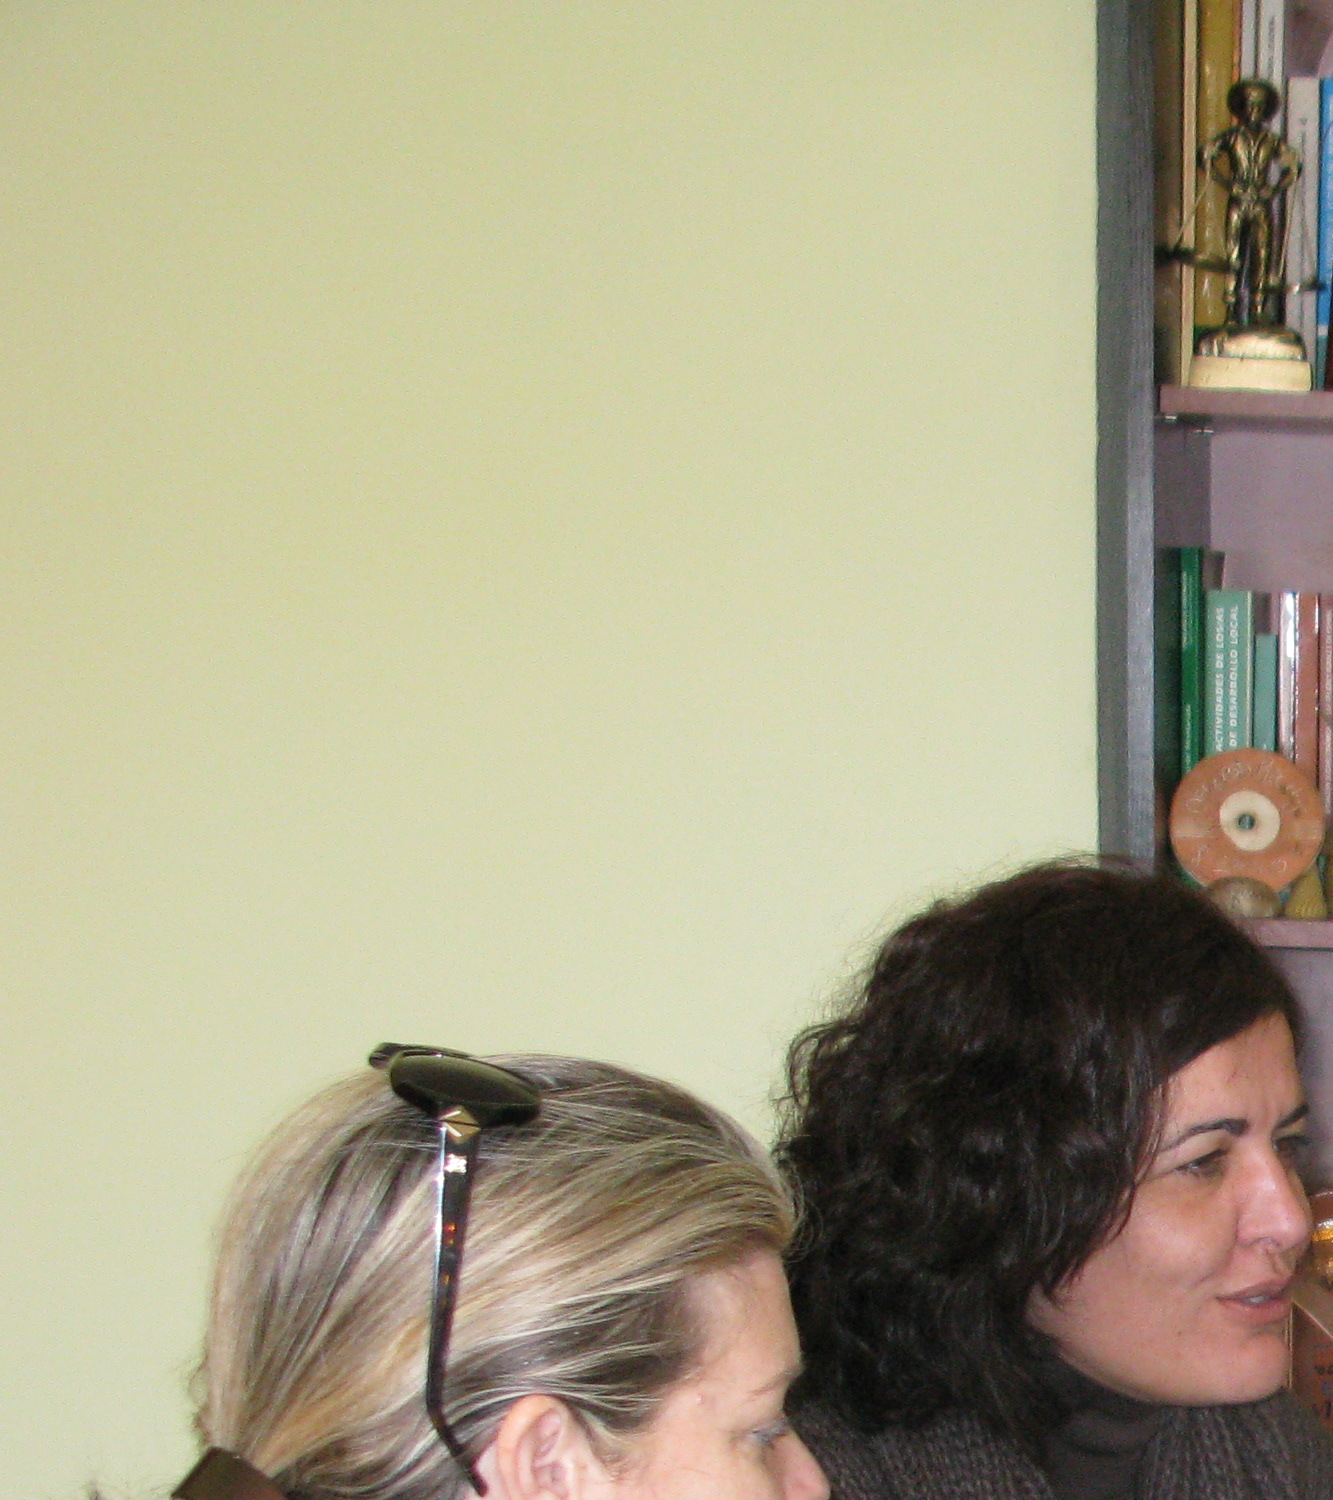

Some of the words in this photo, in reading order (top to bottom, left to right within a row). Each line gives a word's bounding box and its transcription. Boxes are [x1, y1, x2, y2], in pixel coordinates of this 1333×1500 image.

[1230, 604, 1240, 646] LOCAL
[1215, 652, 1225, 670] DE
[1229, 648, 1239, 728] DESARROLLO
[1229, 730, 1238, 748] DE
